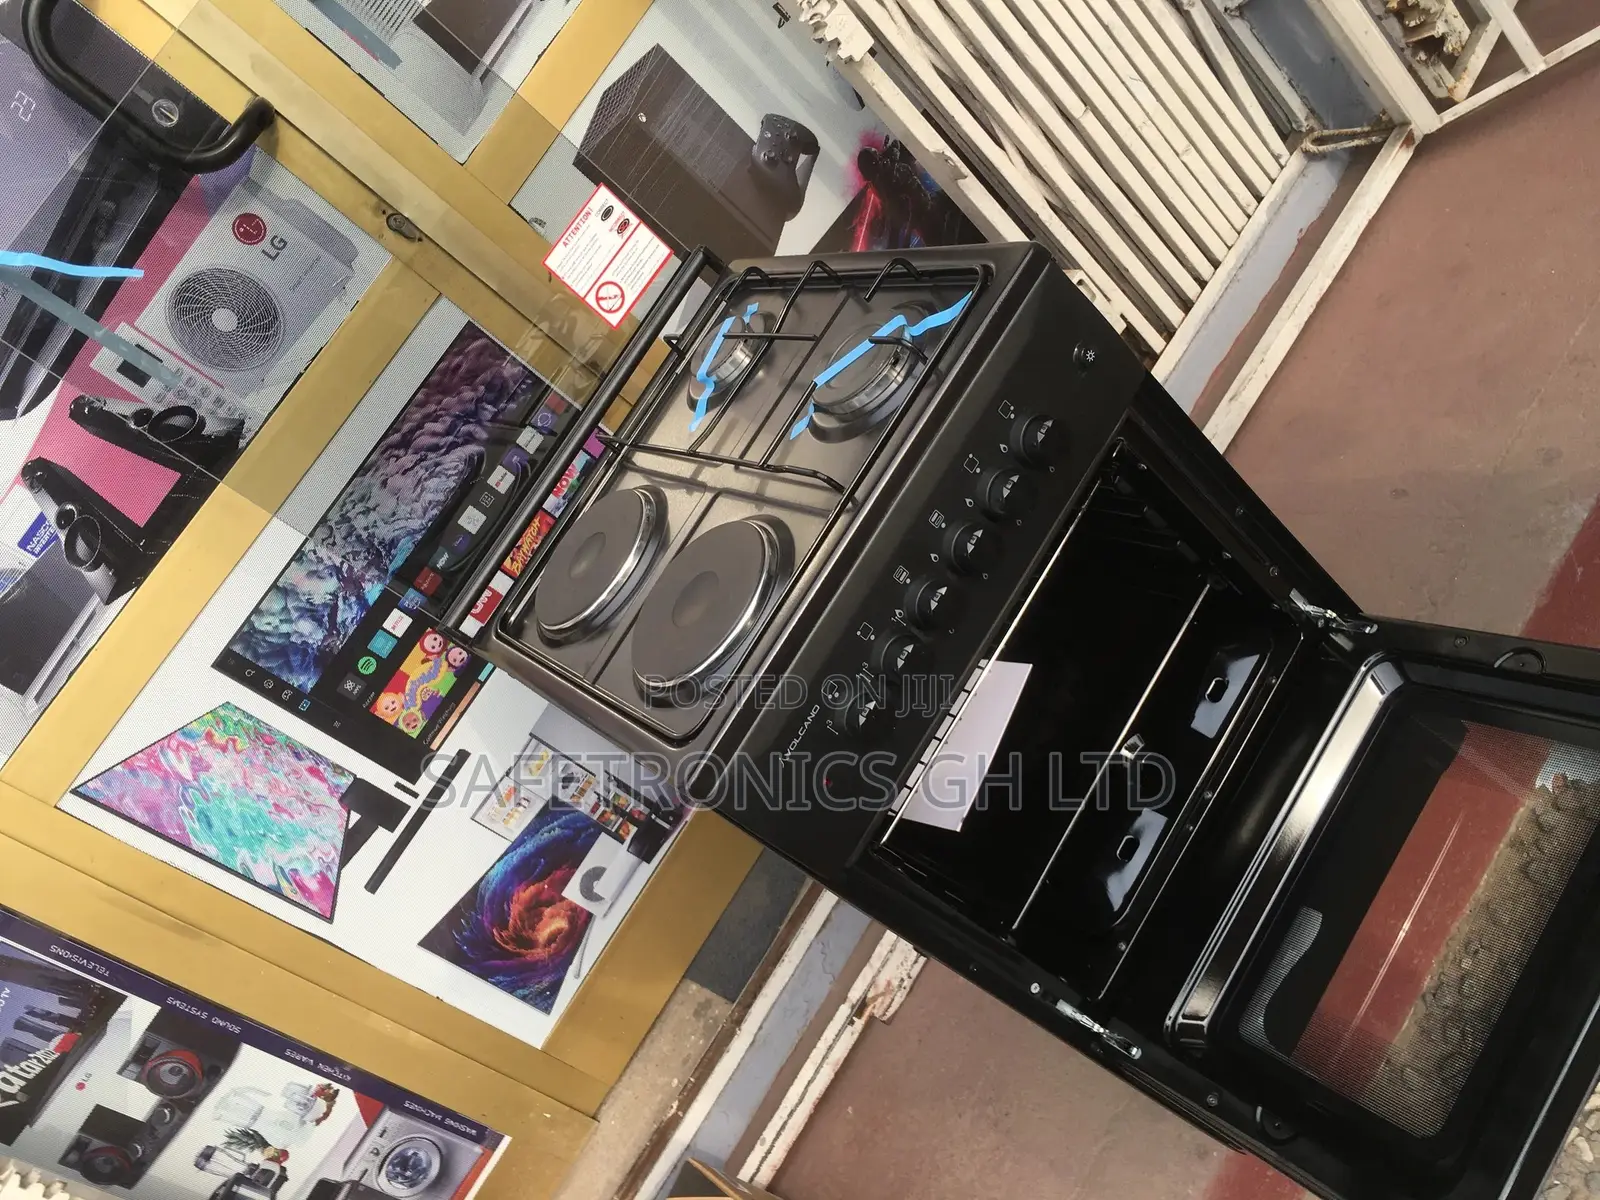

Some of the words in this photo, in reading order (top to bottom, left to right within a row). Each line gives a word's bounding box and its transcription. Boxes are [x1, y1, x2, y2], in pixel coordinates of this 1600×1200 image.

[593, 197, 609, 218] CORRECT
[561, 206, 594, 247] ATTENTION!
[260, 232, 288, 262] LG
[551, 463, 580, 498] NOW
[509, 514, 542, 573] BAYWATCH
[784, 704, 820, 761] VOLCANO
[48, 941, 111, 978] TELEVISIONS
[165, 994, 209, 1021] SYSTEMS
[210, 1014, 242, 1035] SOUND
[283, 1046, 314, 1066] WARES
[316, 1060, 352, 1083] KITCHEN
[402, 1098, 442, 1122] MACHINES
[443, 1115, 478, 1137] WASHING
